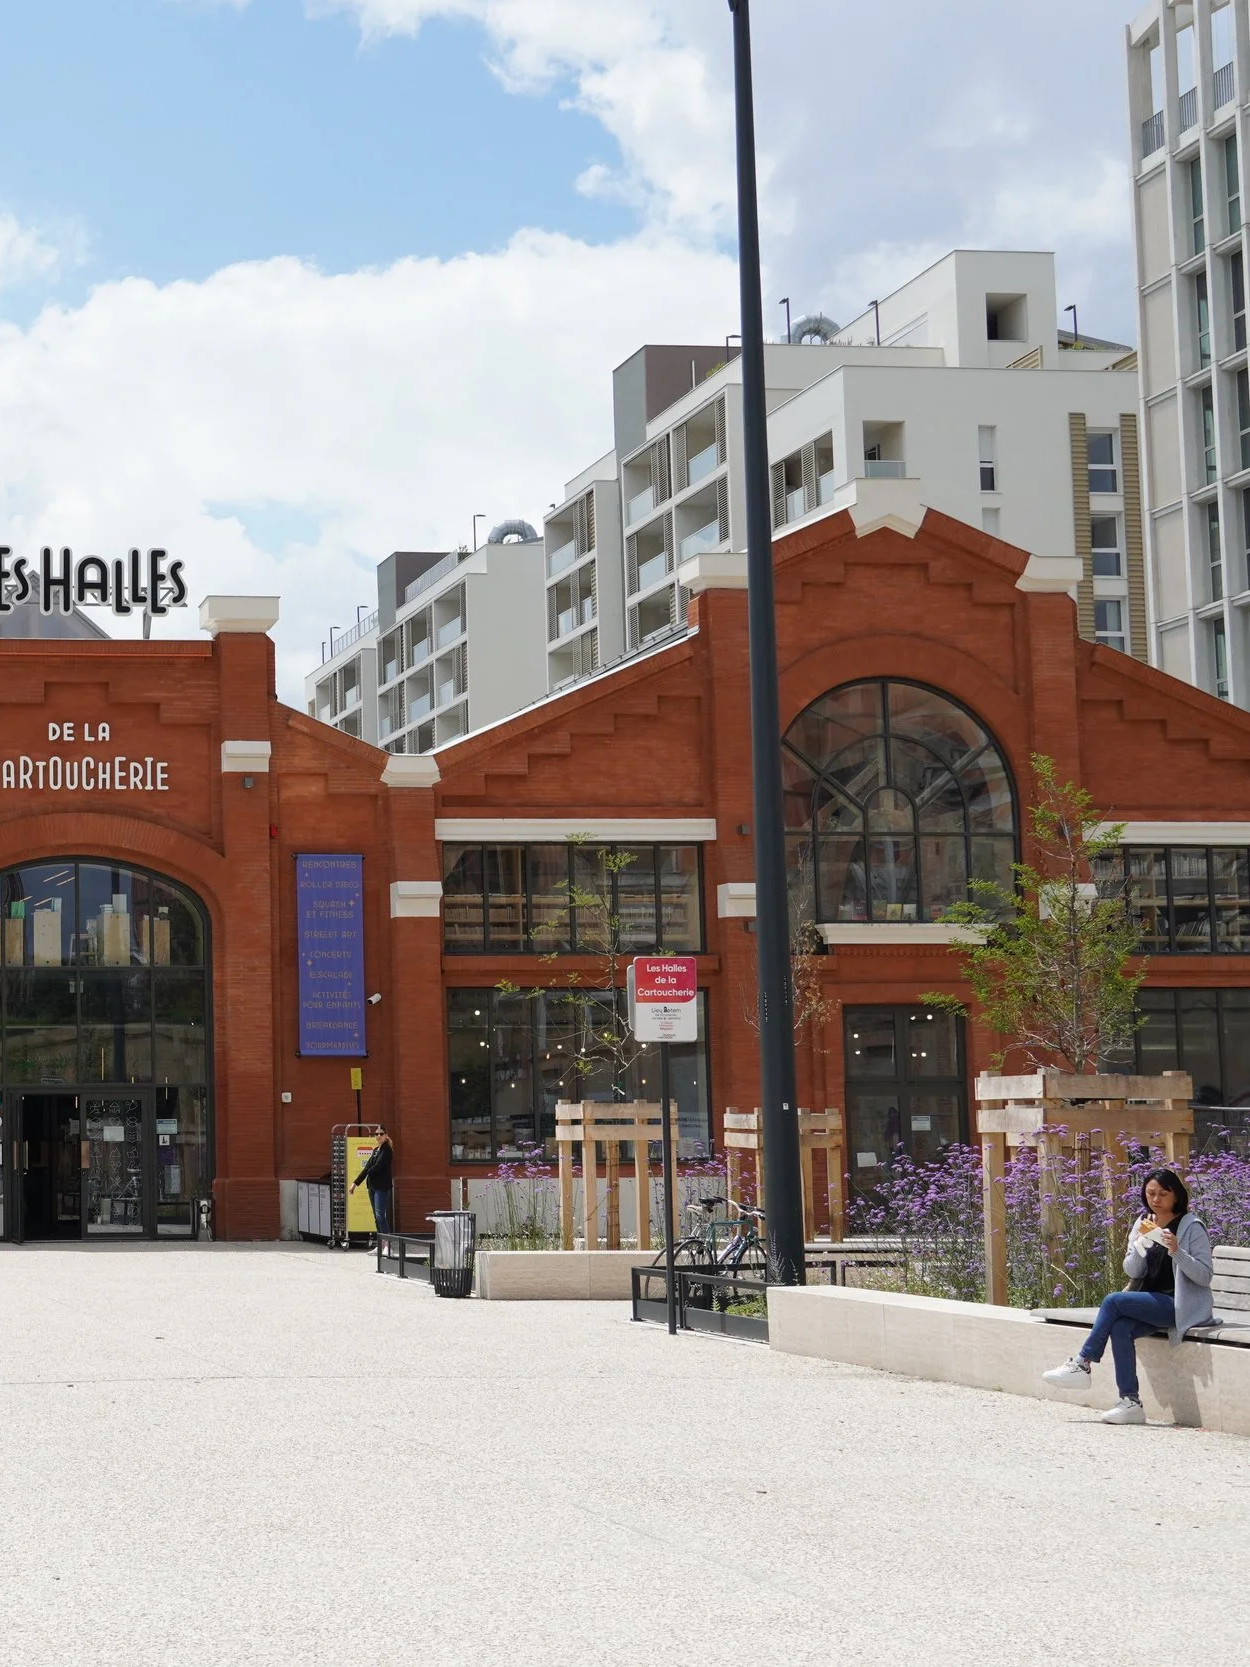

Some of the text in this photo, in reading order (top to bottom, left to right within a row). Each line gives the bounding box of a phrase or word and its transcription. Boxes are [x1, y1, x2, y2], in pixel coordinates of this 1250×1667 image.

[40, 546, 188, 617] HALLES
[48, 722, 110, 741] DE LA
[302, 861, 357, 869] RENCONTRES
[313, 901, 346, 909] SQUASH
[306, 910, 354, 919] ET FITNESS
[303, 930, 356, 939] STREET ART
[309, 951, 352, 959] CONCERTS
[646, 964, 687, 973] Les Halles
[309, 971, 353, 979] ESCALADE
[654, 976, 677, 984] de la
[637, 988, 695, 996] Cartoucherie
[302, 1001, 323, 1009] POUR
